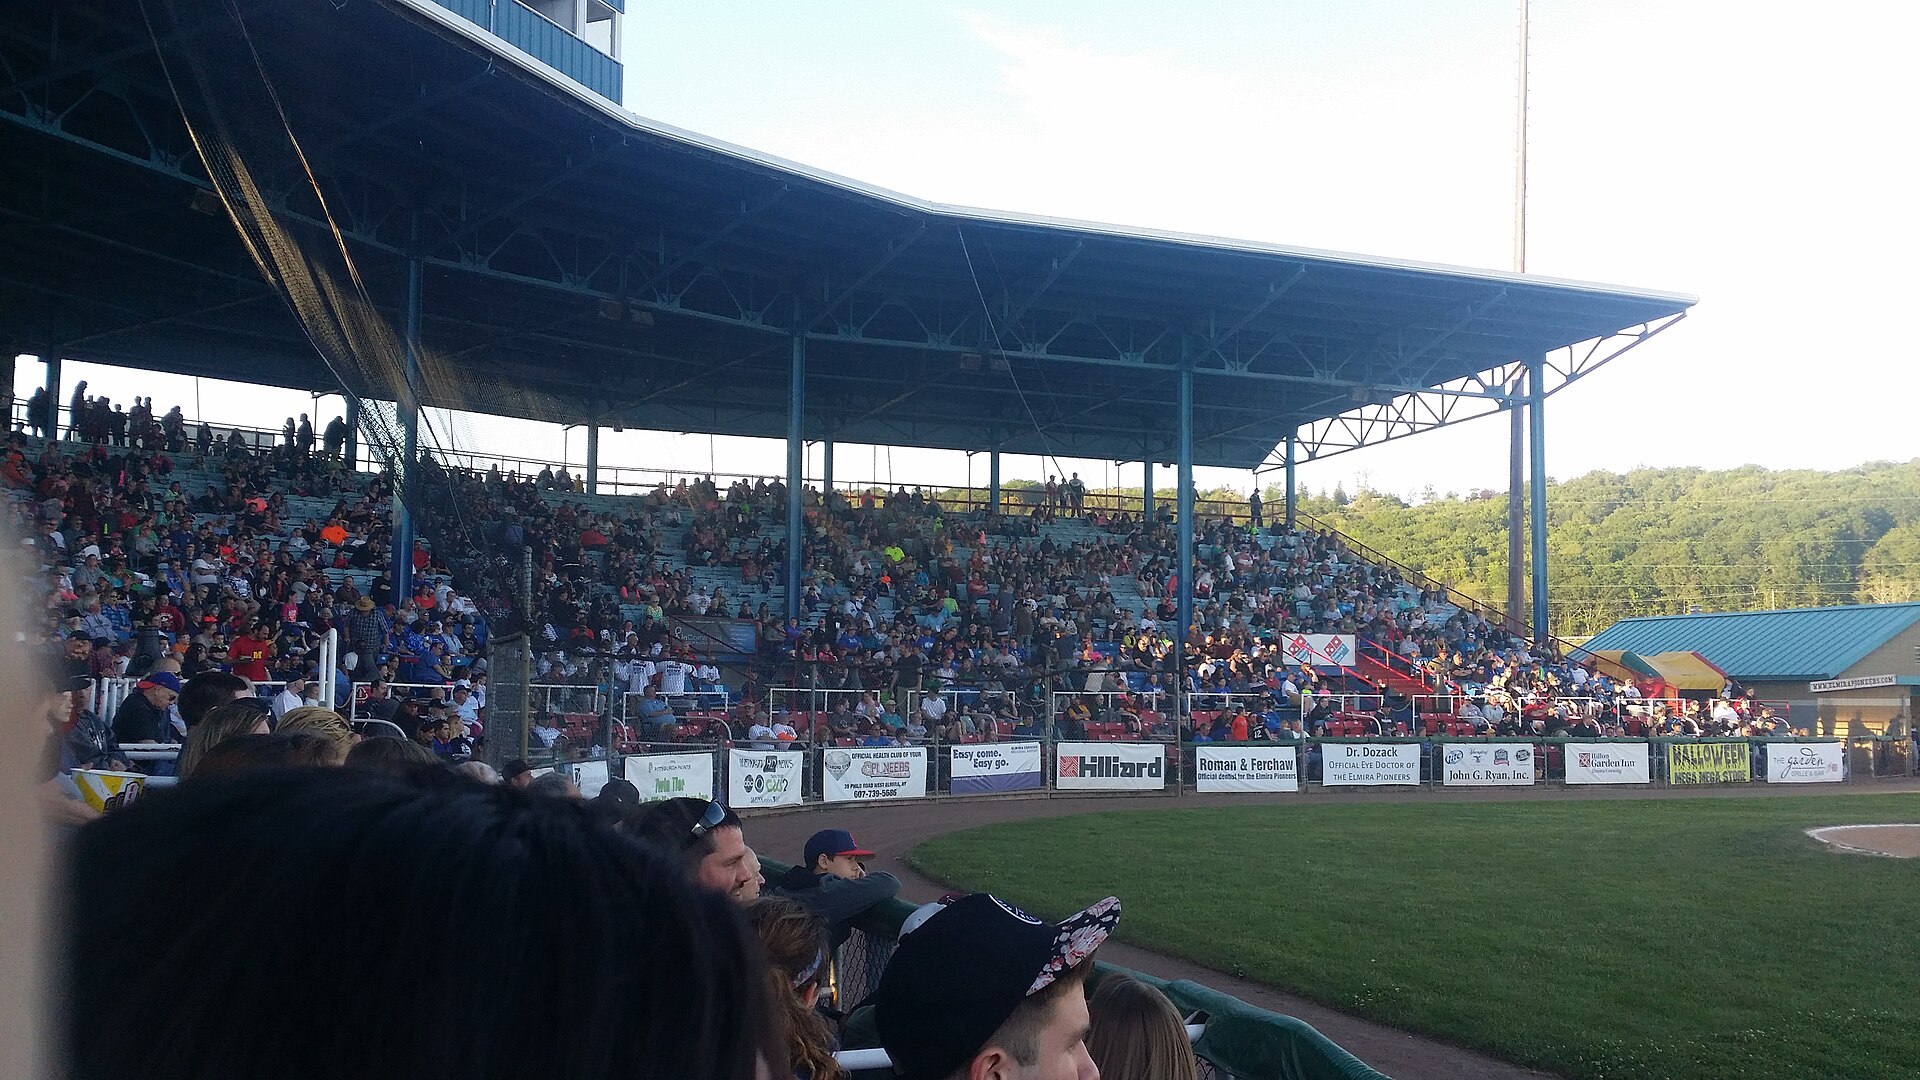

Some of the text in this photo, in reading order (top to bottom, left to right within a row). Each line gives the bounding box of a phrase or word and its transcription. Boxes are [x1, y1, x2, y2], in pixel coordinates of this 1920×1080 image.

[1254, 729, 1262, 738] 12
[952, 749, 1001, 761] Easy come.
[1346, 747, 1398, 757] Dr. Dozack
[1672, 744, 1746, 768] HALLOWEEN
[973, 759, 1009, 769] Easy go.
[1200, 758, 1293, 770] Roman & Ferchaw
[1591, 759, 1635, 767] Garden Inn
[1781, 747, 1824, 778] garden
[1449, 770, 1529, 782] John G. Ryan, Inc.
[1674, 770, 1746, 783] MEGA MEGA STORE
